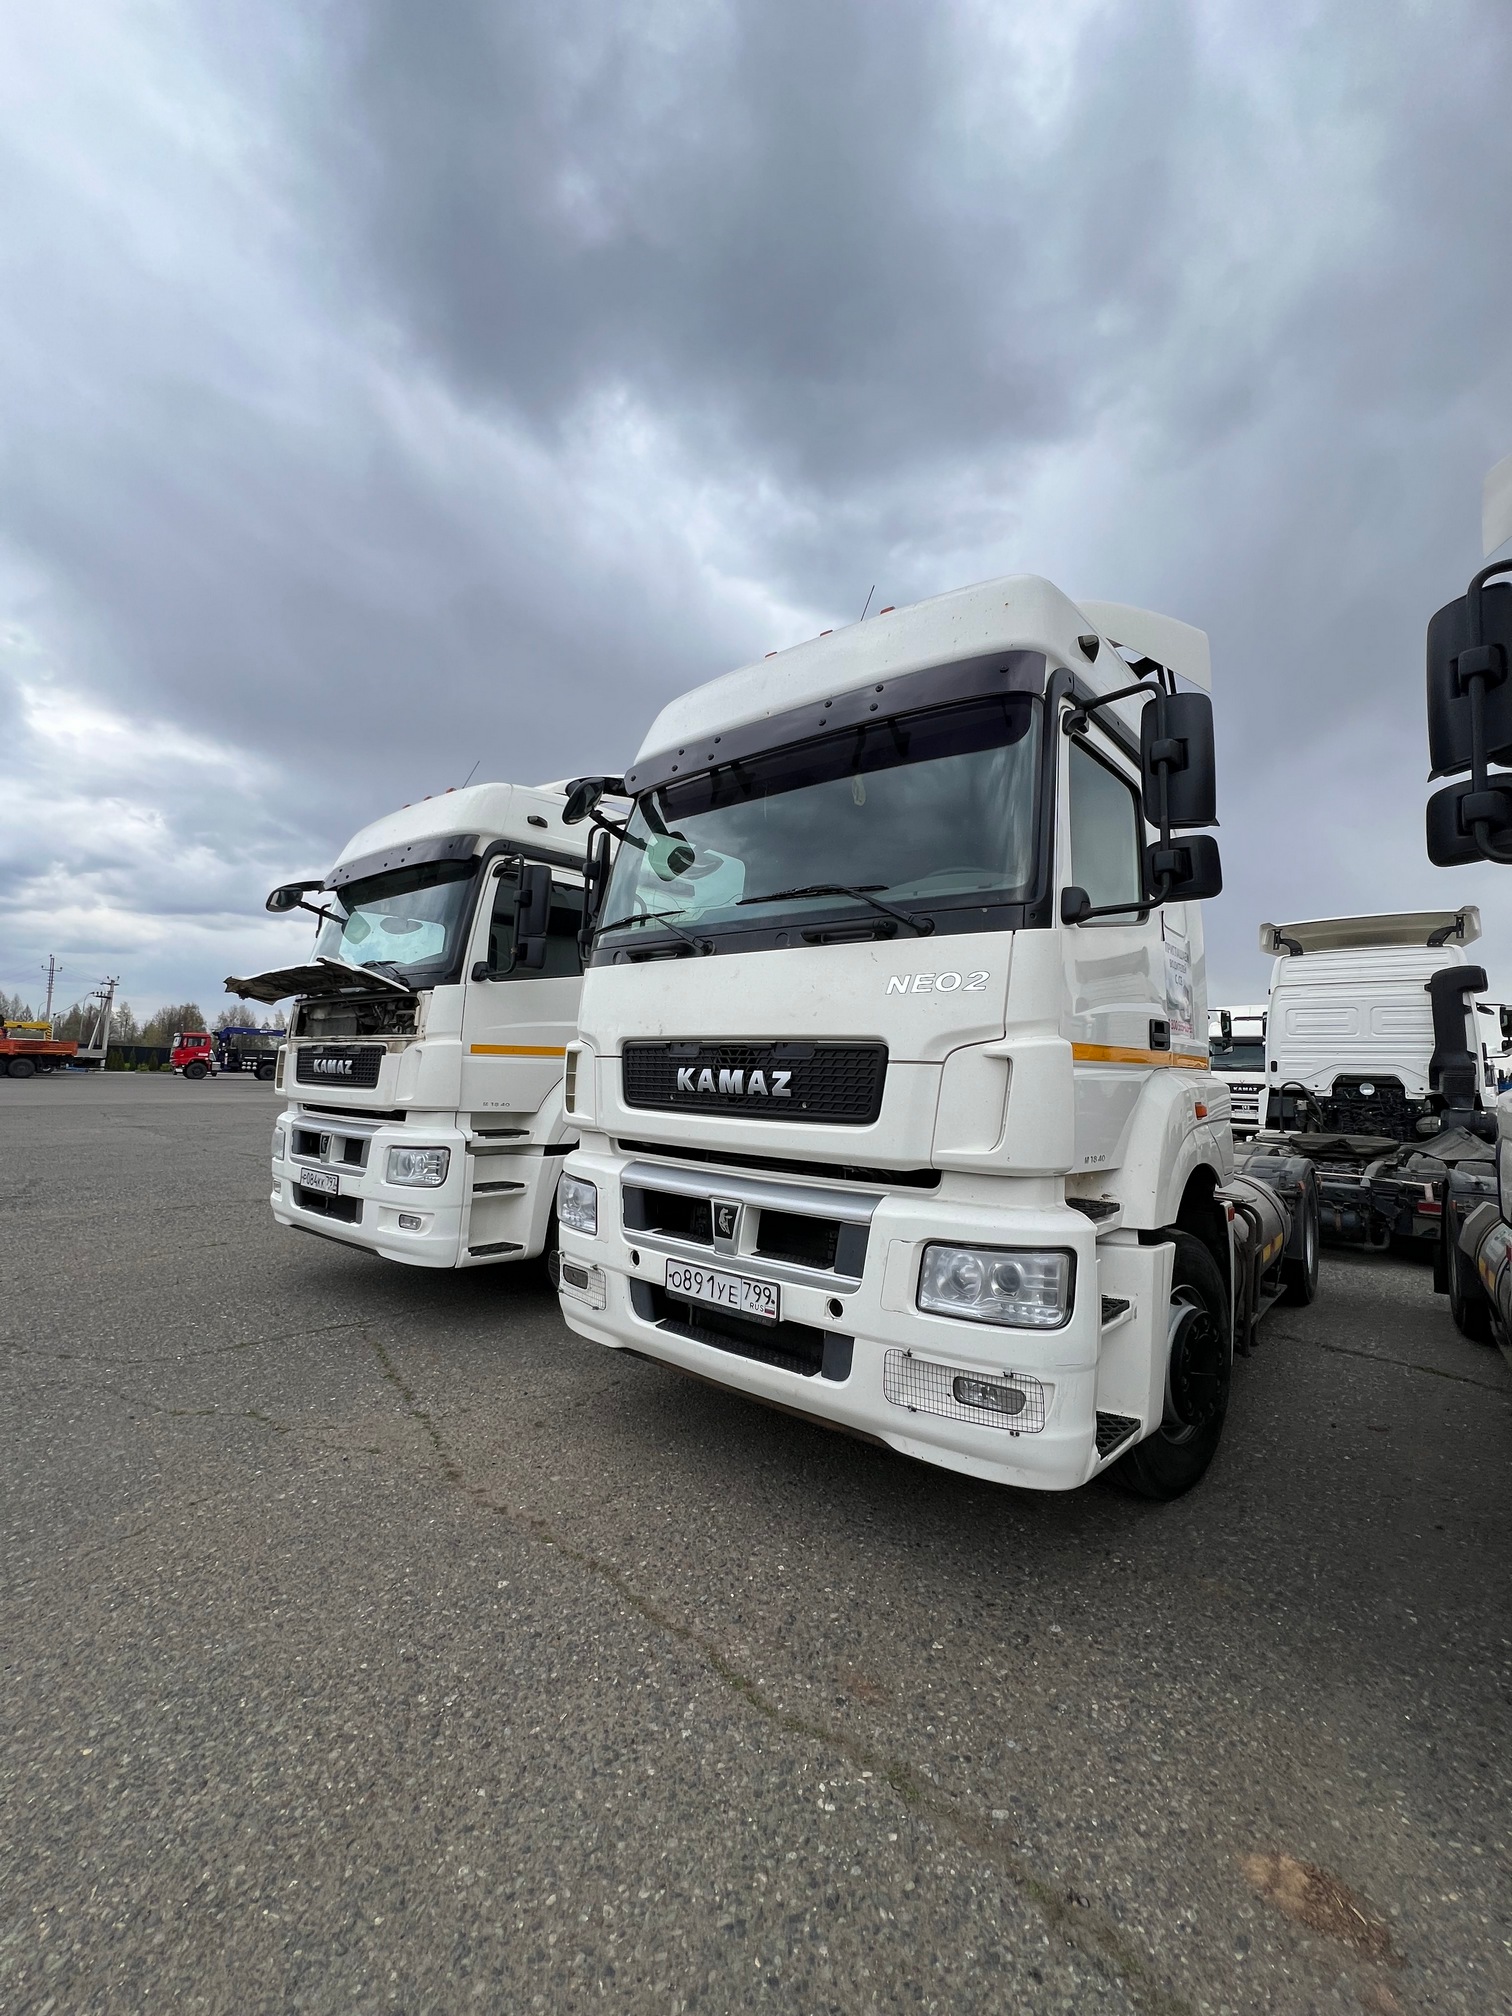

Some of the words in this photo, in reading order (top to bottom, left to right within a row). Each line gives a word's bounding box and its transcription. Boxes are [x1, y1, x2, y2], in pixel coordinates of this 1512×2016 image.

[885, 970, 991, 995] NEO2
[313, 1059, 353, 1075] KAMAZ
[677, 1067, 792, 1098] KAMAZ
[749, 1302, 764, 1312] RUS
